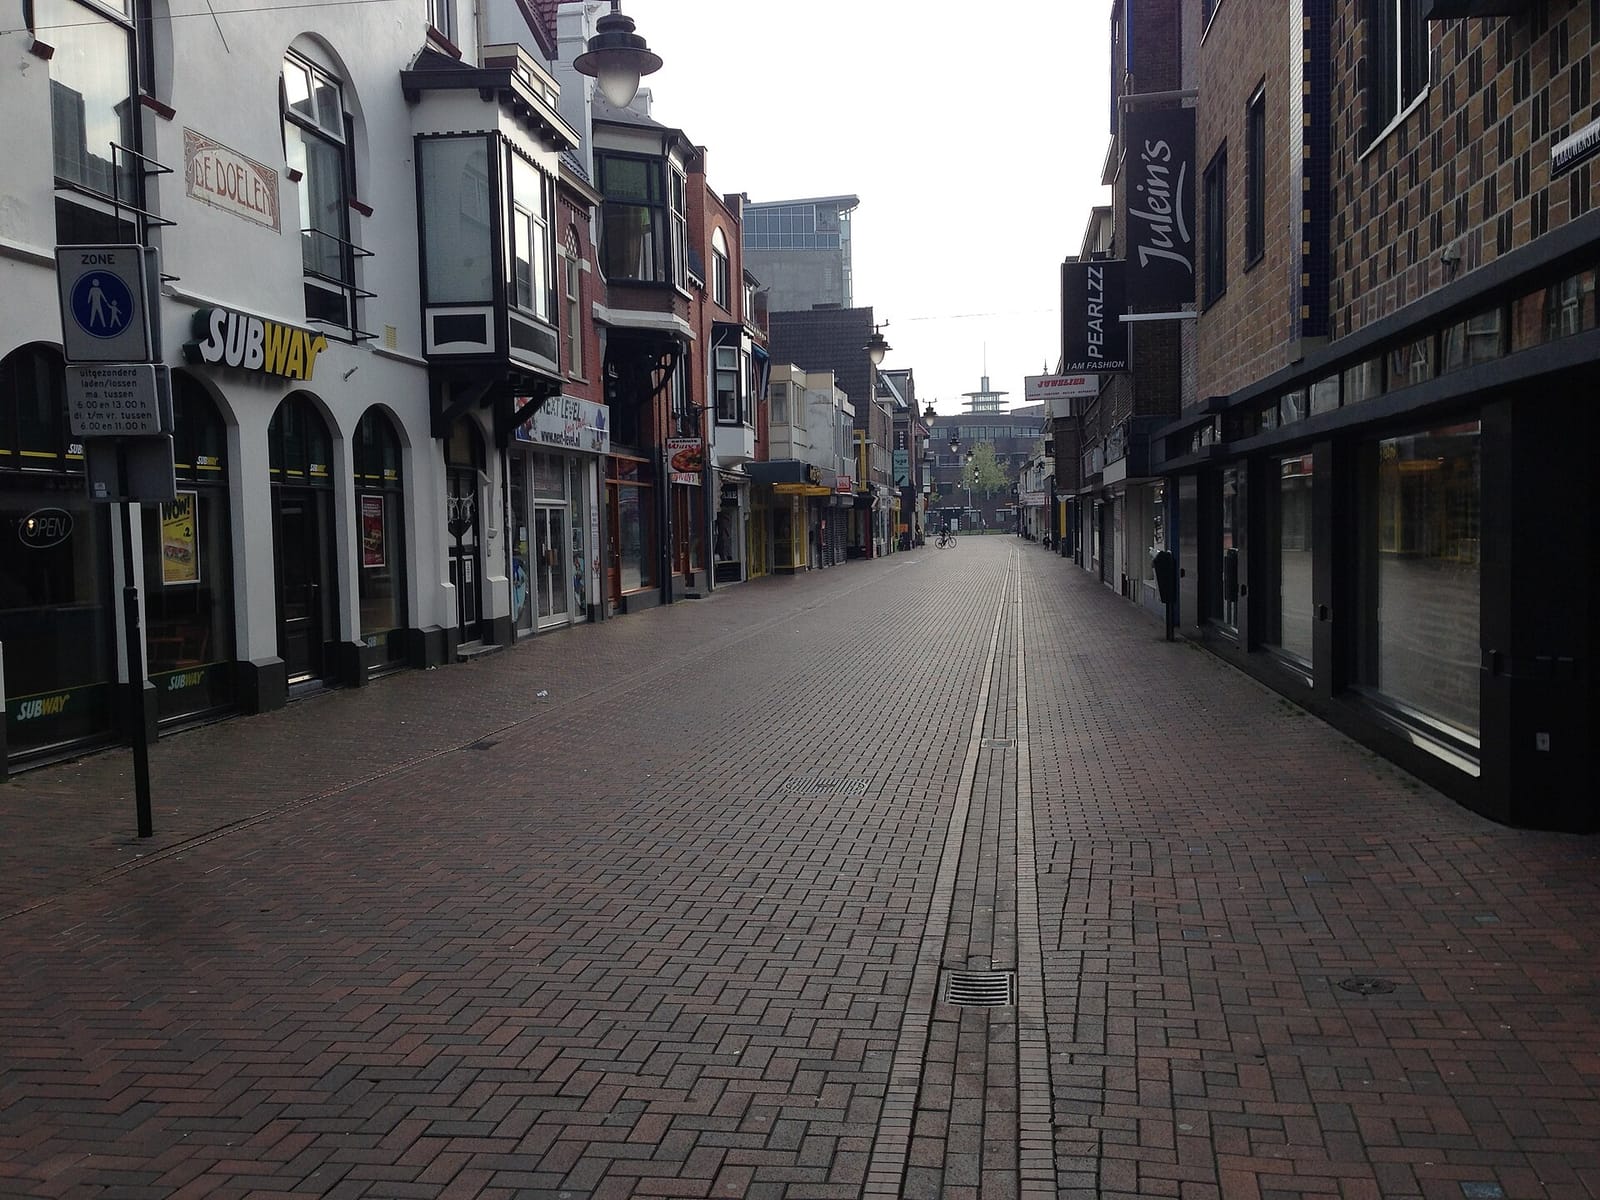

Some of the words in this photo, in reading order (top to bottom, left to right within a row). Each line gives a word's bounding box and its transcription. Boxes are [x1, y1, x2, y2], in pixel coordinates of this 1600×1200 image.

[195, 156, 214, 193] DE
[216, 158, 272, 217] DOELEN
[1129, 138, 1193, 275] Julein's
[81, 254, 115, 265] ZONE
[1088, 266, 1104, 359] PEARLZZ
[199, 307, 329, 382] SUBWAY
[1071, 362, 1085, 370] AM
[1086, 360, 1125, 370] FASHION
[79, 368, 137, 379] uitgezonderd
[81, 379, 137, 388] laden/lossen
[1037, 377, 1086, 388] JUWELIER
[104, 389, 134, 399] tussen
[140, 400, 147, 409] h
[561, 398, 581, 421] LEVEL
[87, 411, 103, 420] t/m
[121, 411, 152, 420] tussen
[140, 421, 147, 430] h
[25, 517, 66, 537] OPEN
[168, 671, 205, 691] SUBWAY
[17, 693, 71, 721] SUBWAY
